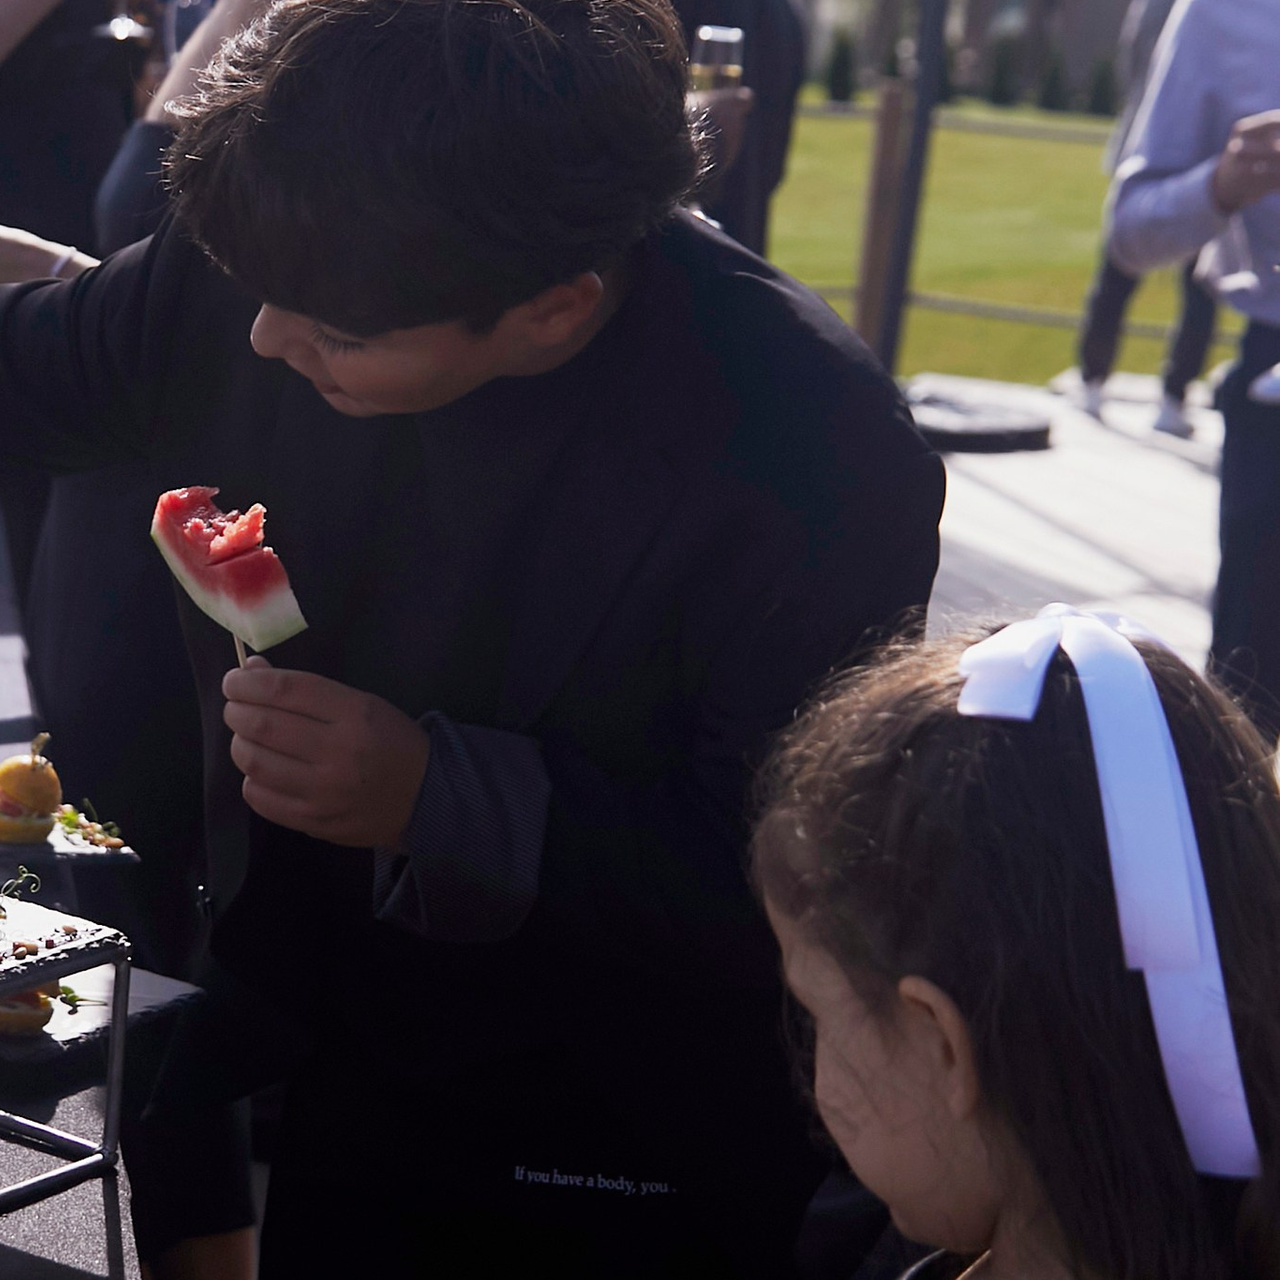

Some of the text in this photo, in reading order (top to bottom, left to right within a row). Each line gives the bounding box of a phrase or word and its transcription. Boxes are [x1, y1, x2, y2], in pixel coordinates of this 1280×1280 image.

[514, 1165, 526, 1180] If
[527, 1170, 550, 1184] you
[551, 1168, 584, 1185] have
[585, 1176, 595, 1187] a
[597, 1173, 636, 1195] body,
[640, 1182, 669, 1195] you
